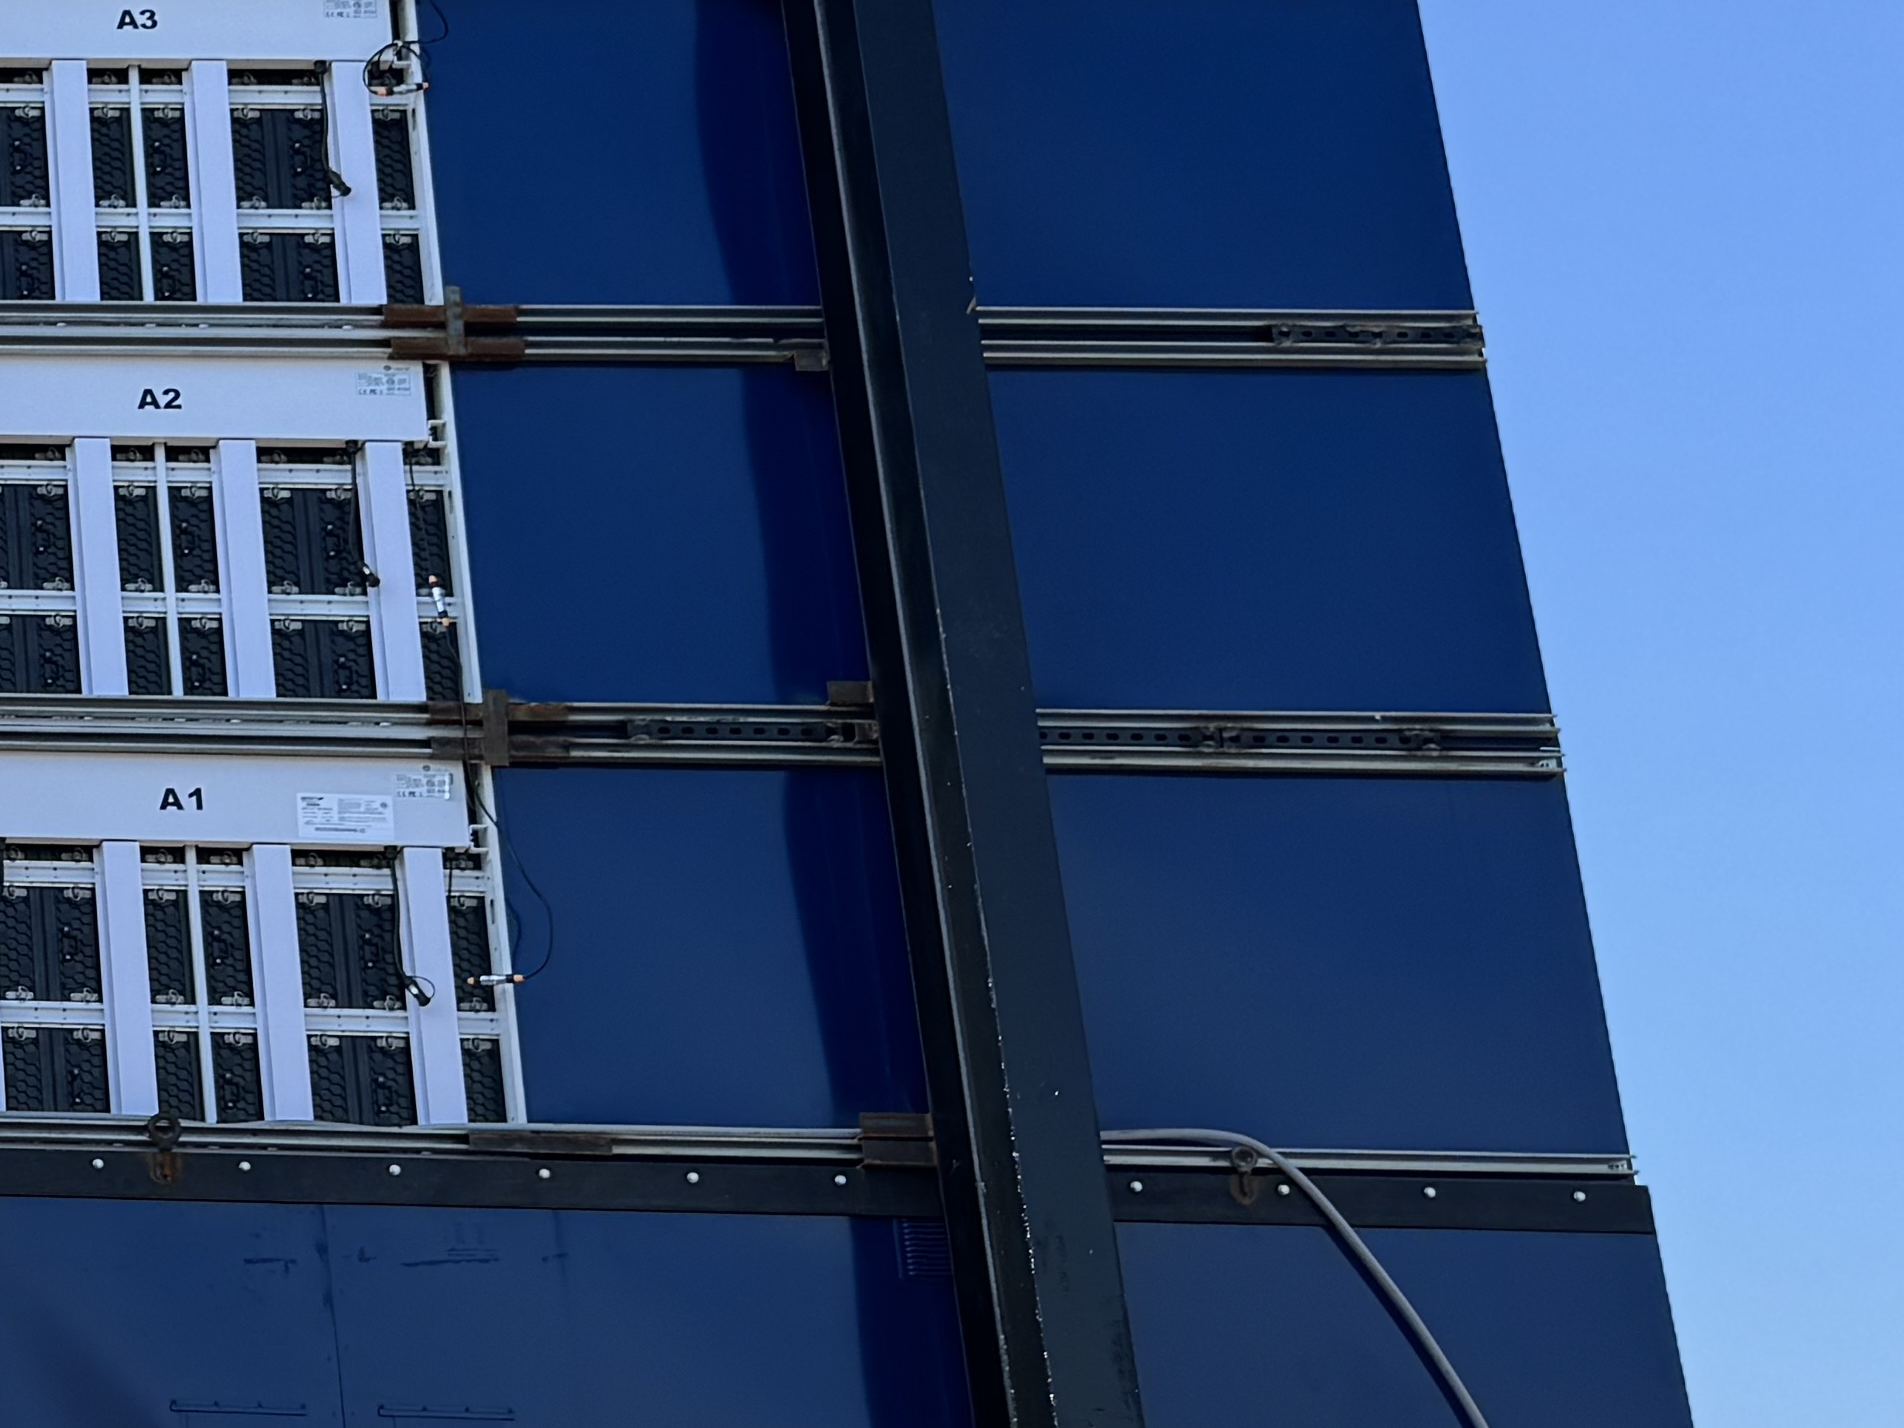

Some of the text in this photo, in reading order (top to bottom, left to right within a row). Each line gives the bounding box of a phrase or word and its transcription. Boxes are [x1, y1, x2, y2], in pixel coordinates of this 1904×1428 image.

[117, 10, 158, 30] A3
[138, 389, 183, 410] A2
[159, 788, 204, 811] A1
